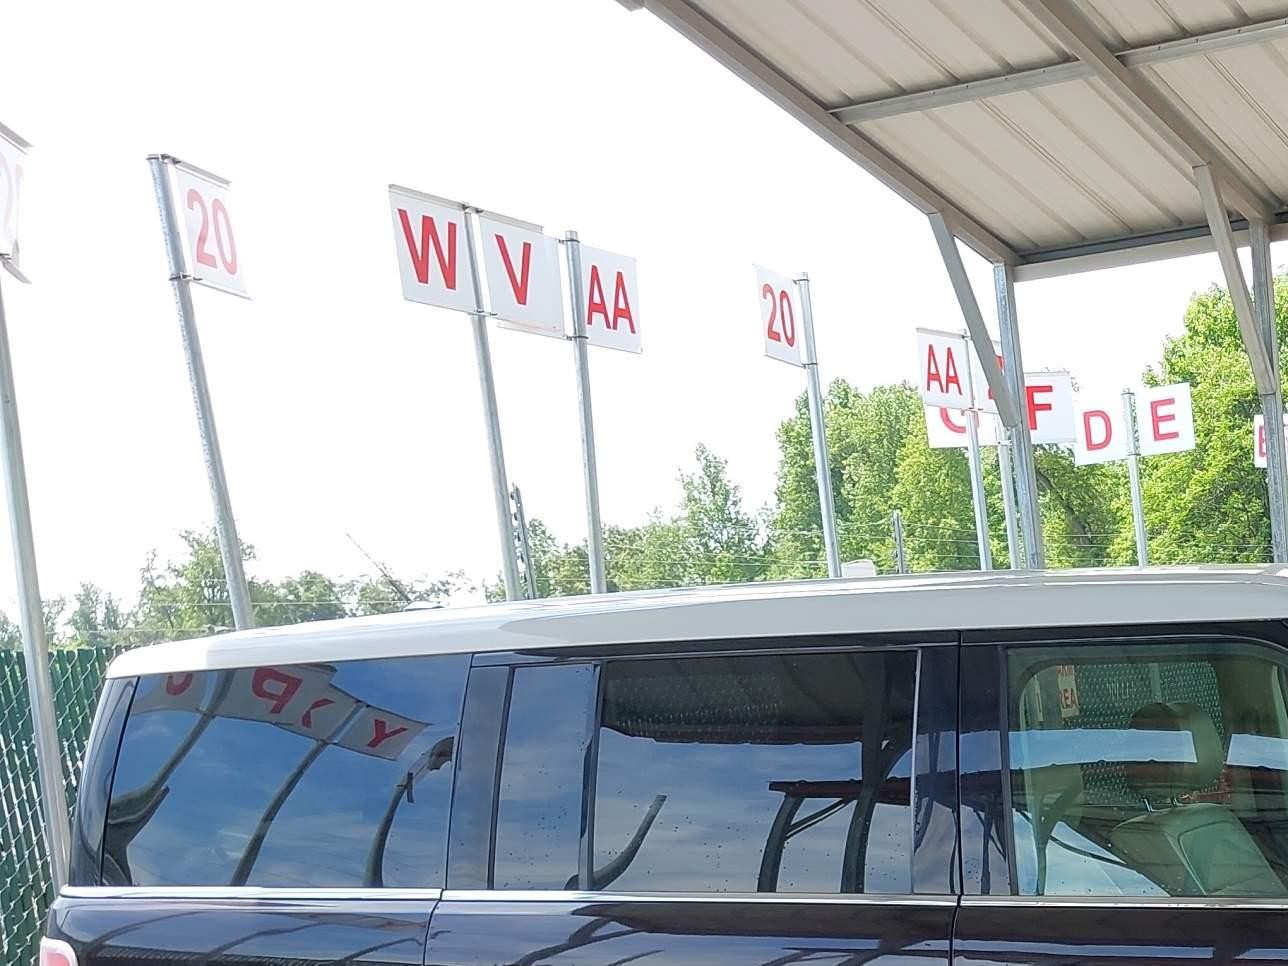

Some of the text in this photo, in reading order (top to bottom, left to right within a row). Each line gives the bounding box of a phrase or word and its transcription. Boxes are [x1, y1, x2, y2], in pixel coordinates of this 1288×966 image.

[187, 188, 237, 275] 20
[397, 208, 457, 290] W
[495, 233, 532, 306] V
[587, 264, 636, 334] AA
[763, 283, 795, 347] 20
[927, 344, 963, 395] AA
[1025, 386, 1053, 430] F
[1083, 410, 1112, 451] D
[1150, 398, 1179, 441] E
